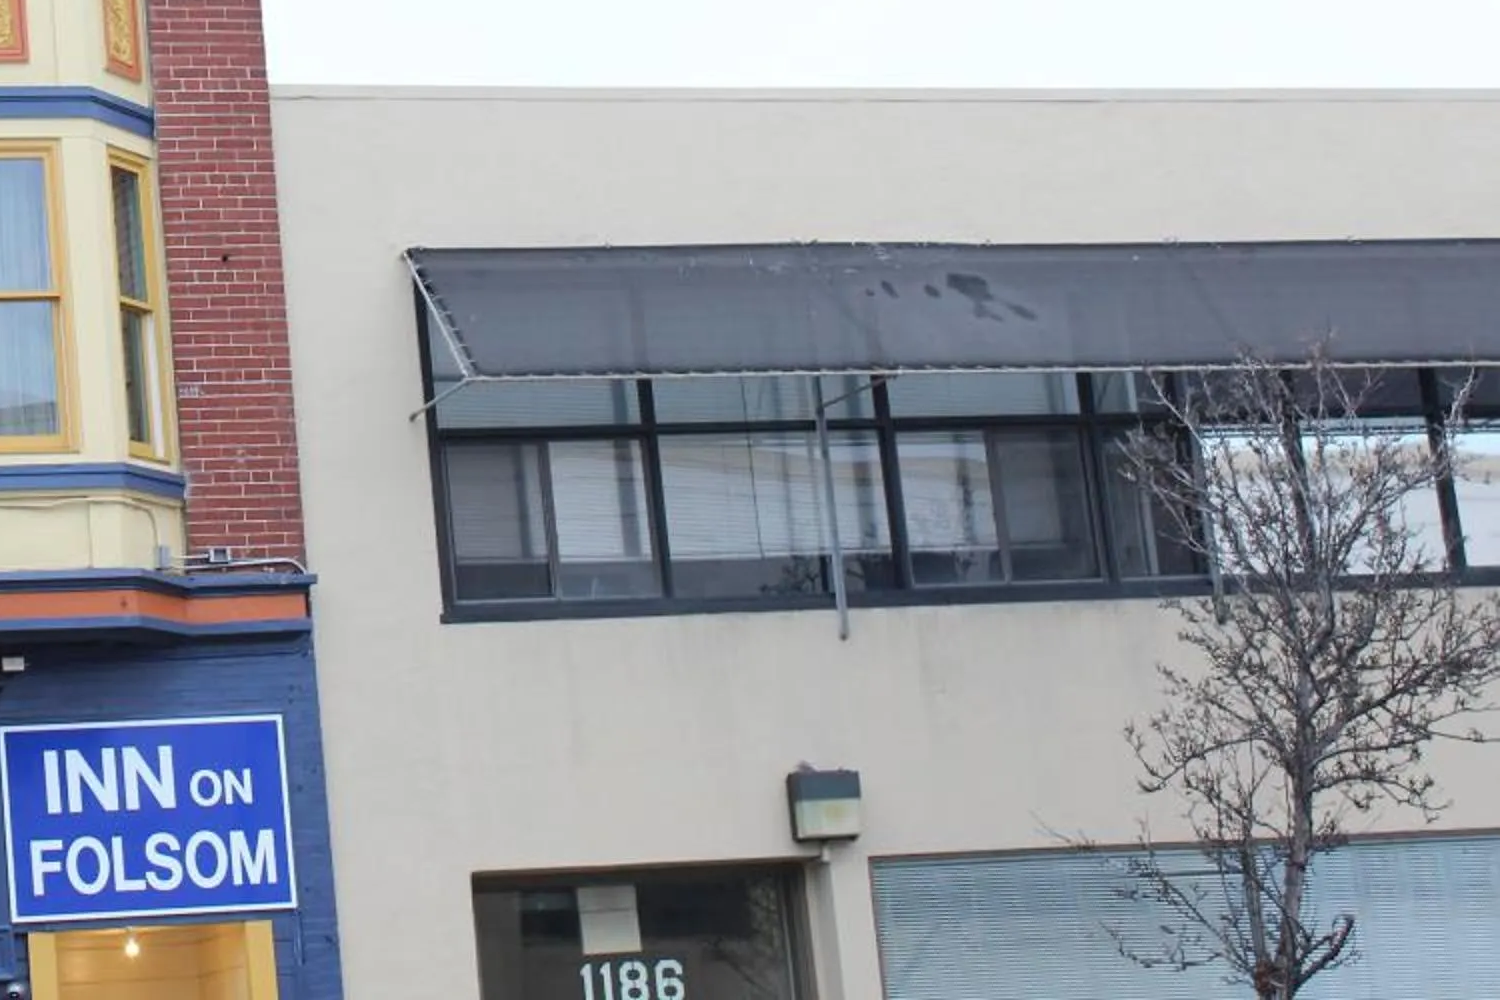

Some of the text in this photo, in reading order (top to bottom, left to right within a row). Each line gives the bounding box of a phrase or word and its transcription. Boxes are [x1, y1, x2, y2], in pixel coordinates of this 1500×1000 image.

[43, 745, 253, 815] INN ON
[29, 828, 278, 897] FOLSOM
[579, 959, 685, 1000] 1186
